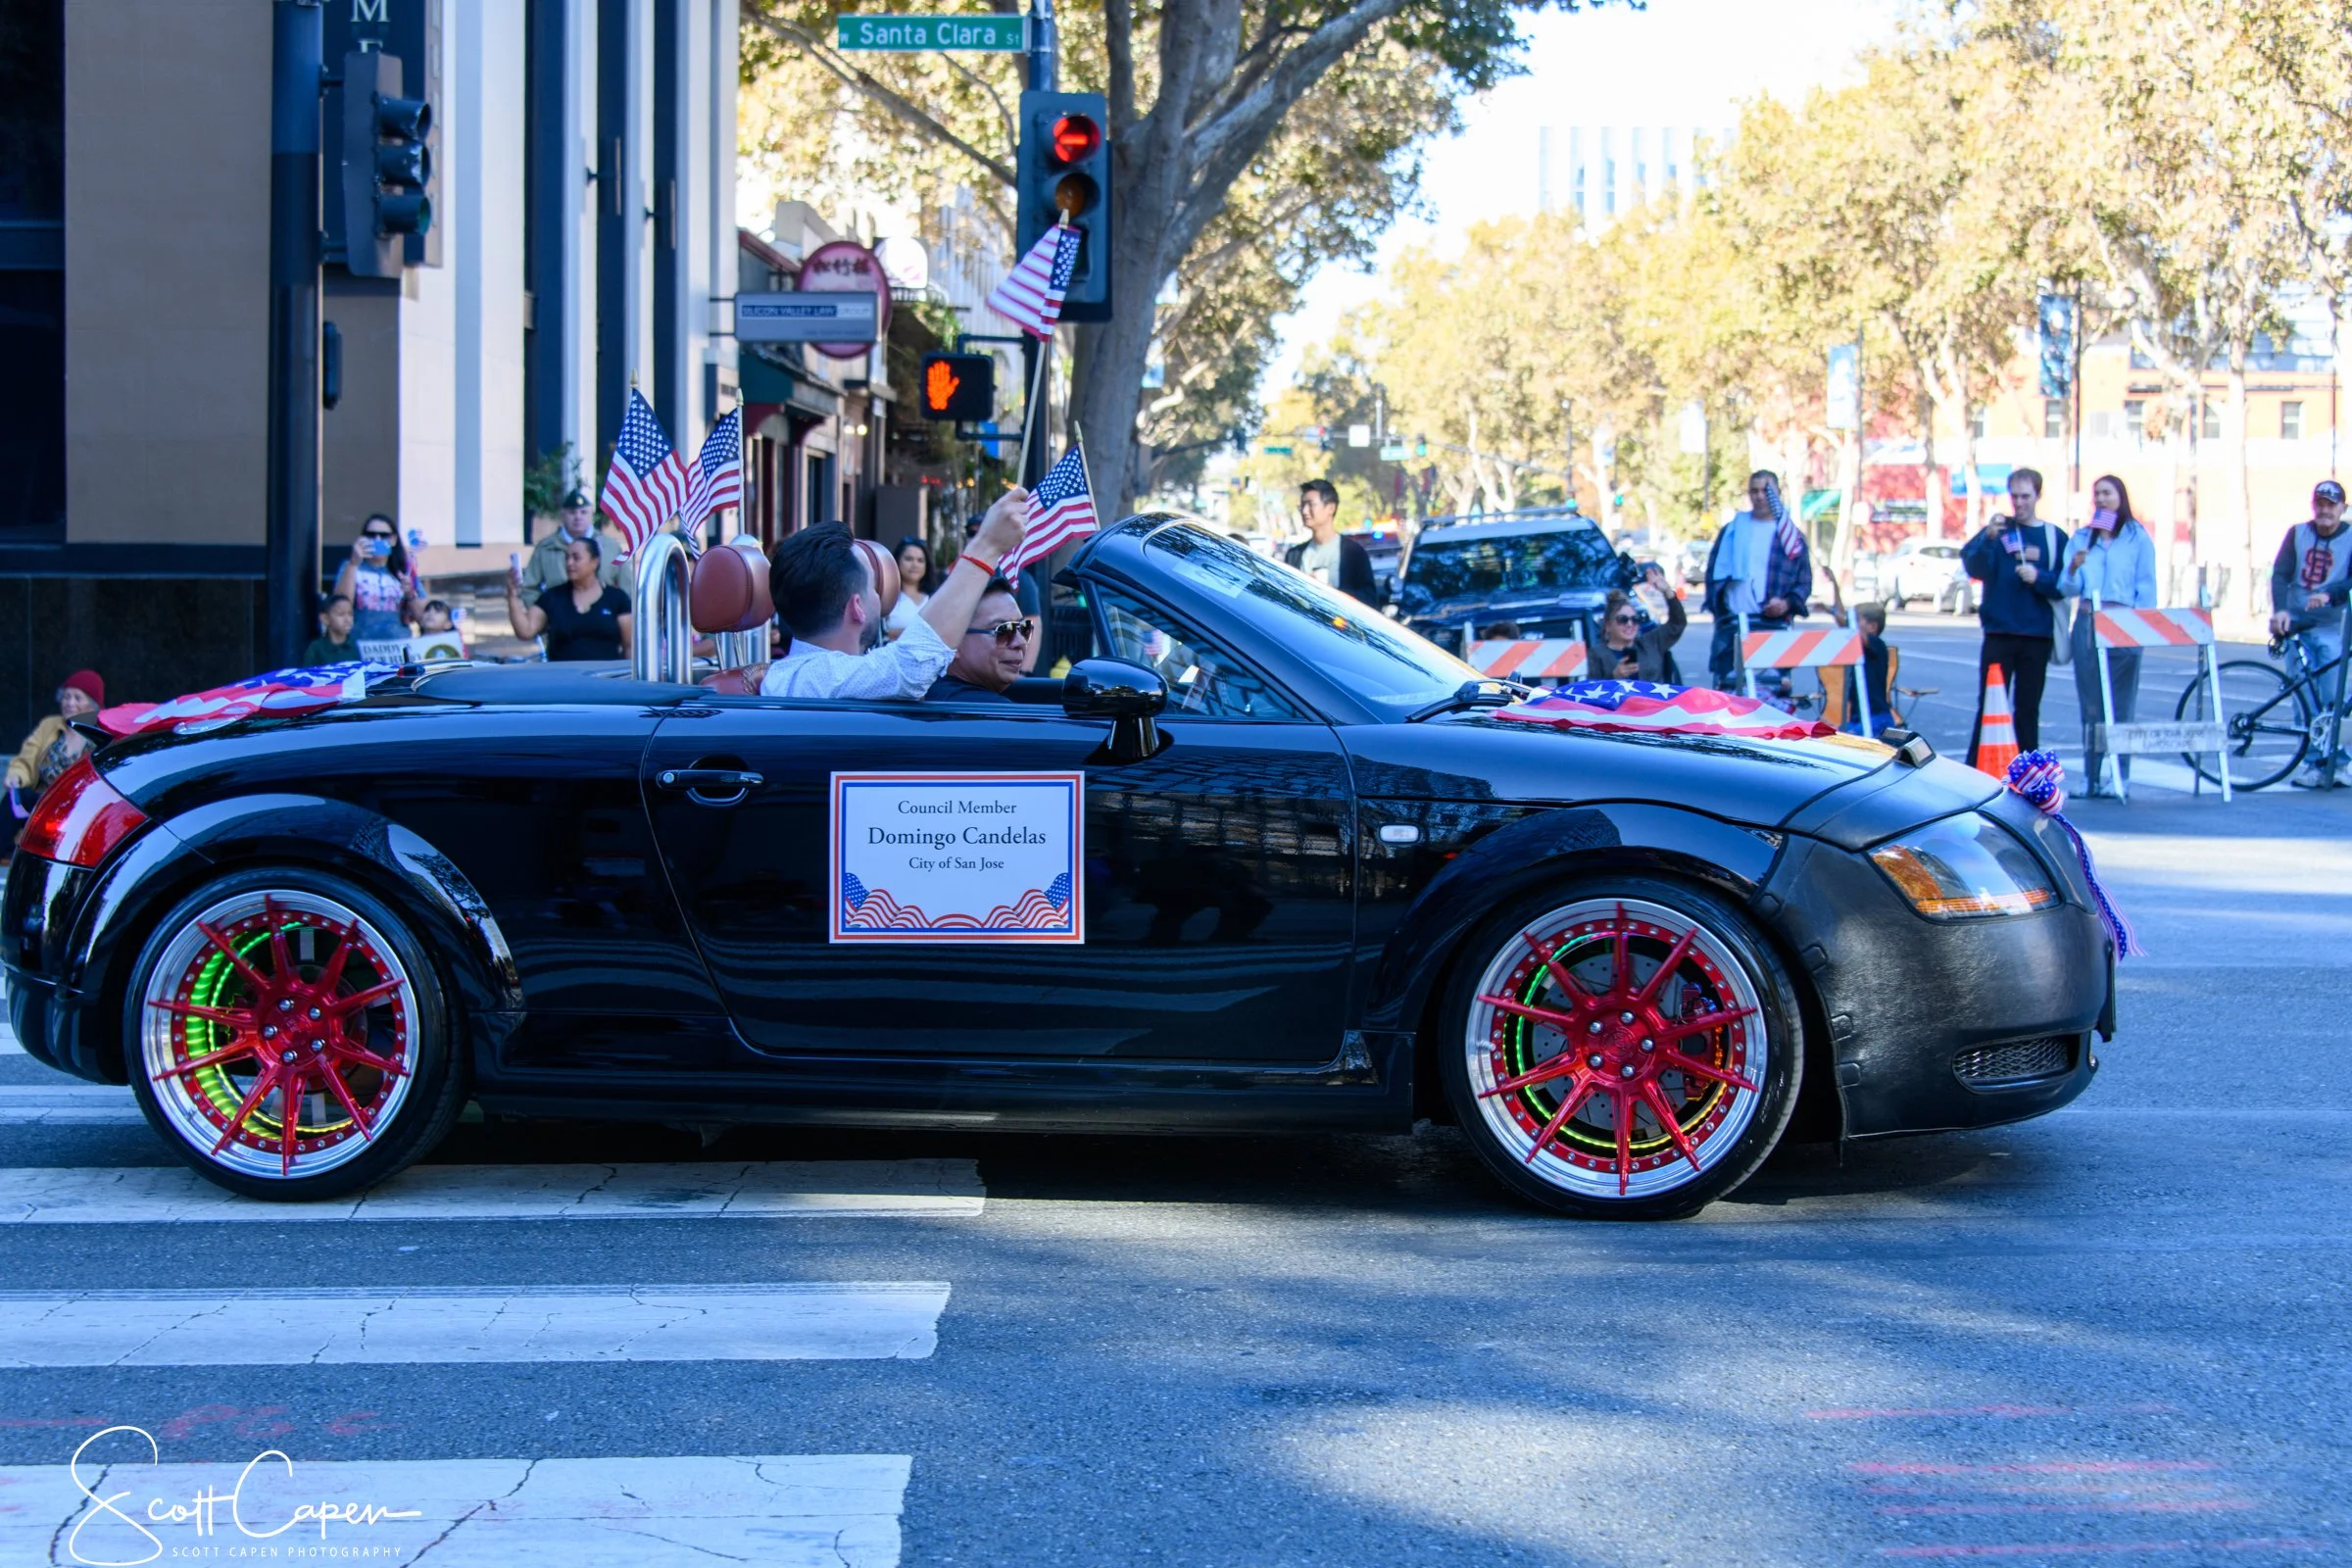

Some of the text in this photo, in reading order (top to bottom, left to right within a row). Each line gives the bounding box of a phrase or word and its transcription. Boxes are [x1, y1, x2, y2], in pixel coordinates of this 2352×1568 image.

[840, 22, 1020, 45] W Santa Clara St
[742, 306, 778, 317] SILICON
[780, 306, 812, 317] VALLEY
[813, 306, 836, 317] LAW
[898, 800, 1017, 814] Council Member
[867, 826, 1046, 850] Domingo Candelas
[908, 857, 1004, 871] City of San Jose
